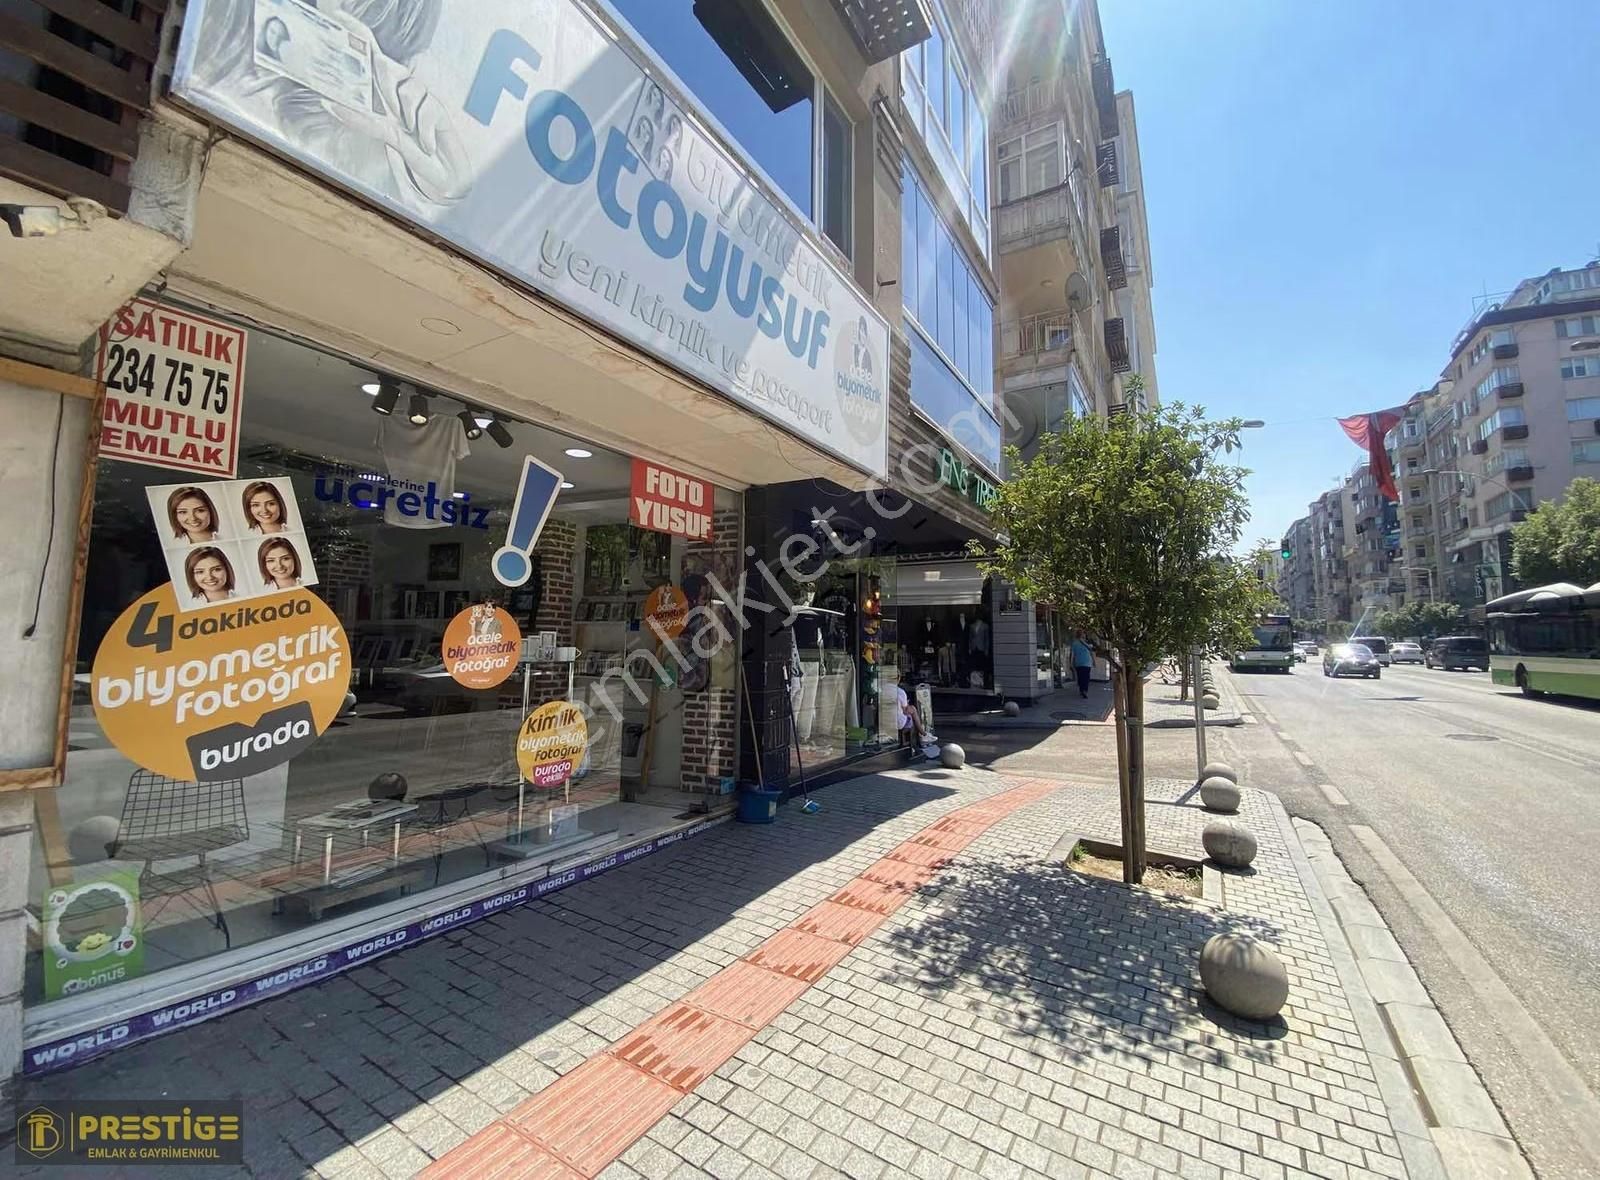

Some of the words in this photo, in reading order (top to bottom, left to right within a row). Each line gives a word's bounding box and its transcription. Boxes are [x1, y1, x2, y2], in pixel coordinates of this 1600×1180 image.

[115, 305, 234, 364] SATILIK
[537, 229, 629, 307] yeni
[630, 284, 715, 364] kimlik
[721, 345, 748, 383] ve
[750, 371, 833, 433] pasaport
[107, 344, 156, 397] 234
[163, 358, 194, 407] 75
[201, 368, 230, 414] 75
[837, 371, 882, 403] biyometrik
[104, 397, 226, 443] MUTLU
[101, 426, 225, 466] EMLAK
[646, 466, 704, 508] FOTO
[635, 497, 712, 539] YUSUF
[126, 601, 174, 653] 4
[178, 599, 311, 640] dakikada
[467, 632, 503, 646] acele
[98, 625, 341, 709] biyometrik
[447, 640, 517, 661] biyometrik
[453, 655, 510, 674] fotoğraf
[176, 652, 342, 724] fotoğraf
[200, 720, 310, 770] burada
[520, 729, 586, 753] biyometrik
[535, 742, 584, 761] fotoğraf
[535, 761, 571, 777] burada
[33, 1025, 129, 1065] WORLD
[152, 990, 236, 1028] WORLD
[256, 960, 328, 991] WORLD
[347, 931, 407, 960] WORLD
[421, 908, 471, 932] WORLD
[483, 889, 526, 910] WORLD
[538, 872, 576, 893] WORLD
[584, 857, 617, 875] WORLD
[624, 845, 653, 860] WORLD
[78, 966, 126, 990] bonus
